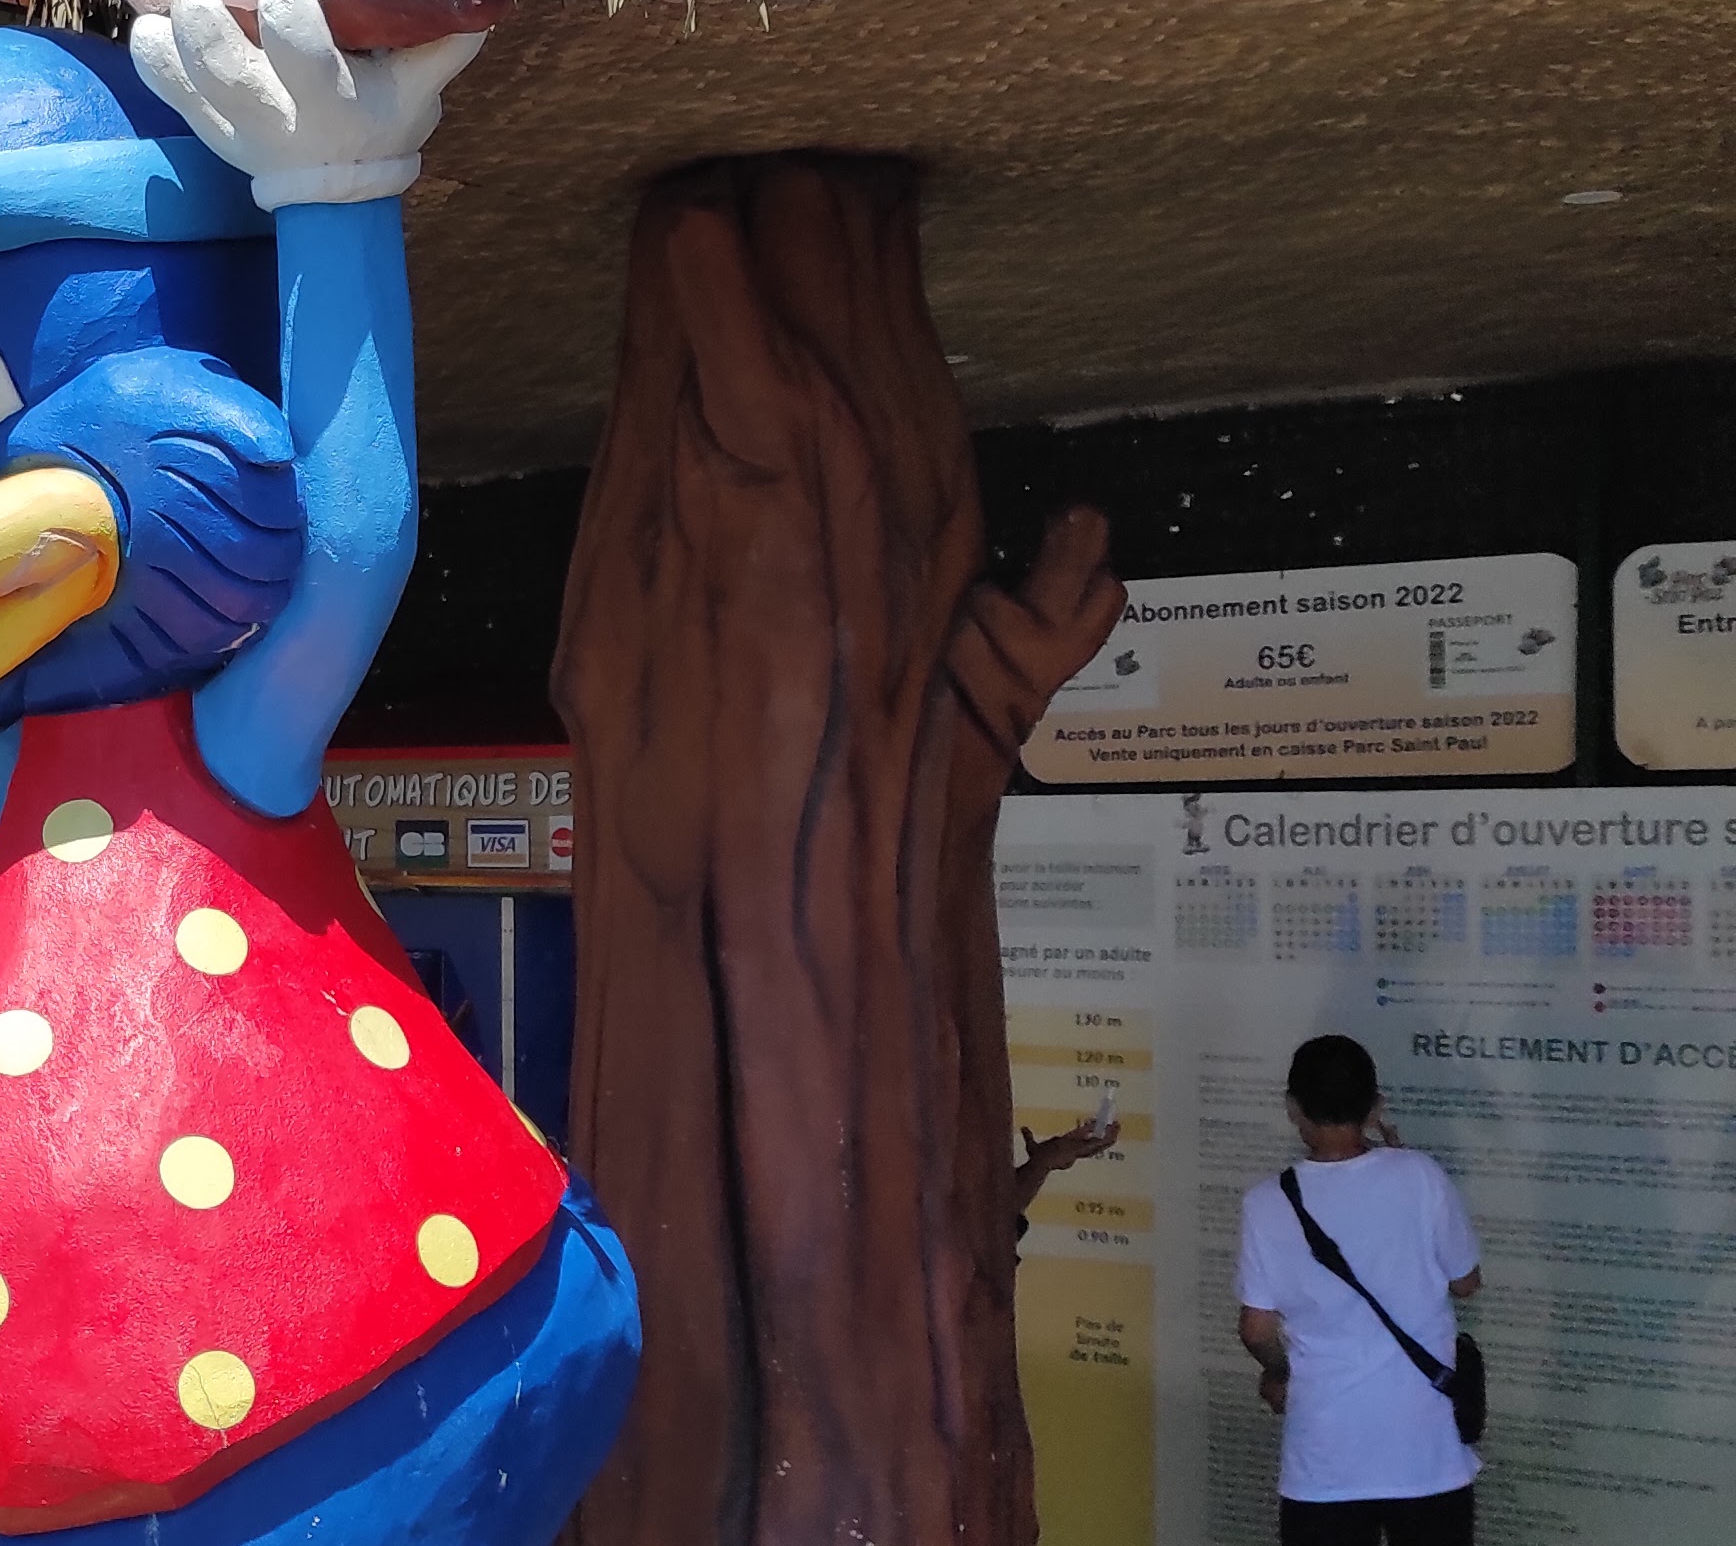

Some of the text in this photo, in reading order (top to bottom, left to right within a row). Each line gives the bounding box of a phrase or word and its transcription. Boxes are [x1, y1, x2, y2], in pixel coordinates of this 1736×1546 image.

[1123, 582, 1464, 623] Abonnement saison 2022
[1257, 643, 1315, 670] 65€
[1111, 728, 1132, 739] au
[1138, 725, 1177, 739] Parc
[1181, 723, 1220, 737] tous
[1224, 722, 1251, 736] les
[1255, 720, 1301, 738] jours
[1421, 713, 1484, 730] saison
[1490, 710, 1539, 726] 2022
[1089, 747, 1138, 762] Vente
[1142, 744, 1245, 761] uniquement
[1251, 745, 1273, 756] en
[1277, 741, 1336, 756] caisse
[1343, 739, 1385, 754] Parc
[320, 770, 572, 808] UTOMATIQUE DE
[480, 835, 516, 853] VISA
[1224, 812, 1438, 848] Calendrier
[1451, 810, 1708, 847] d'ouverture
[1413, 1029, 1610, 1064] RÈGLEMENT
